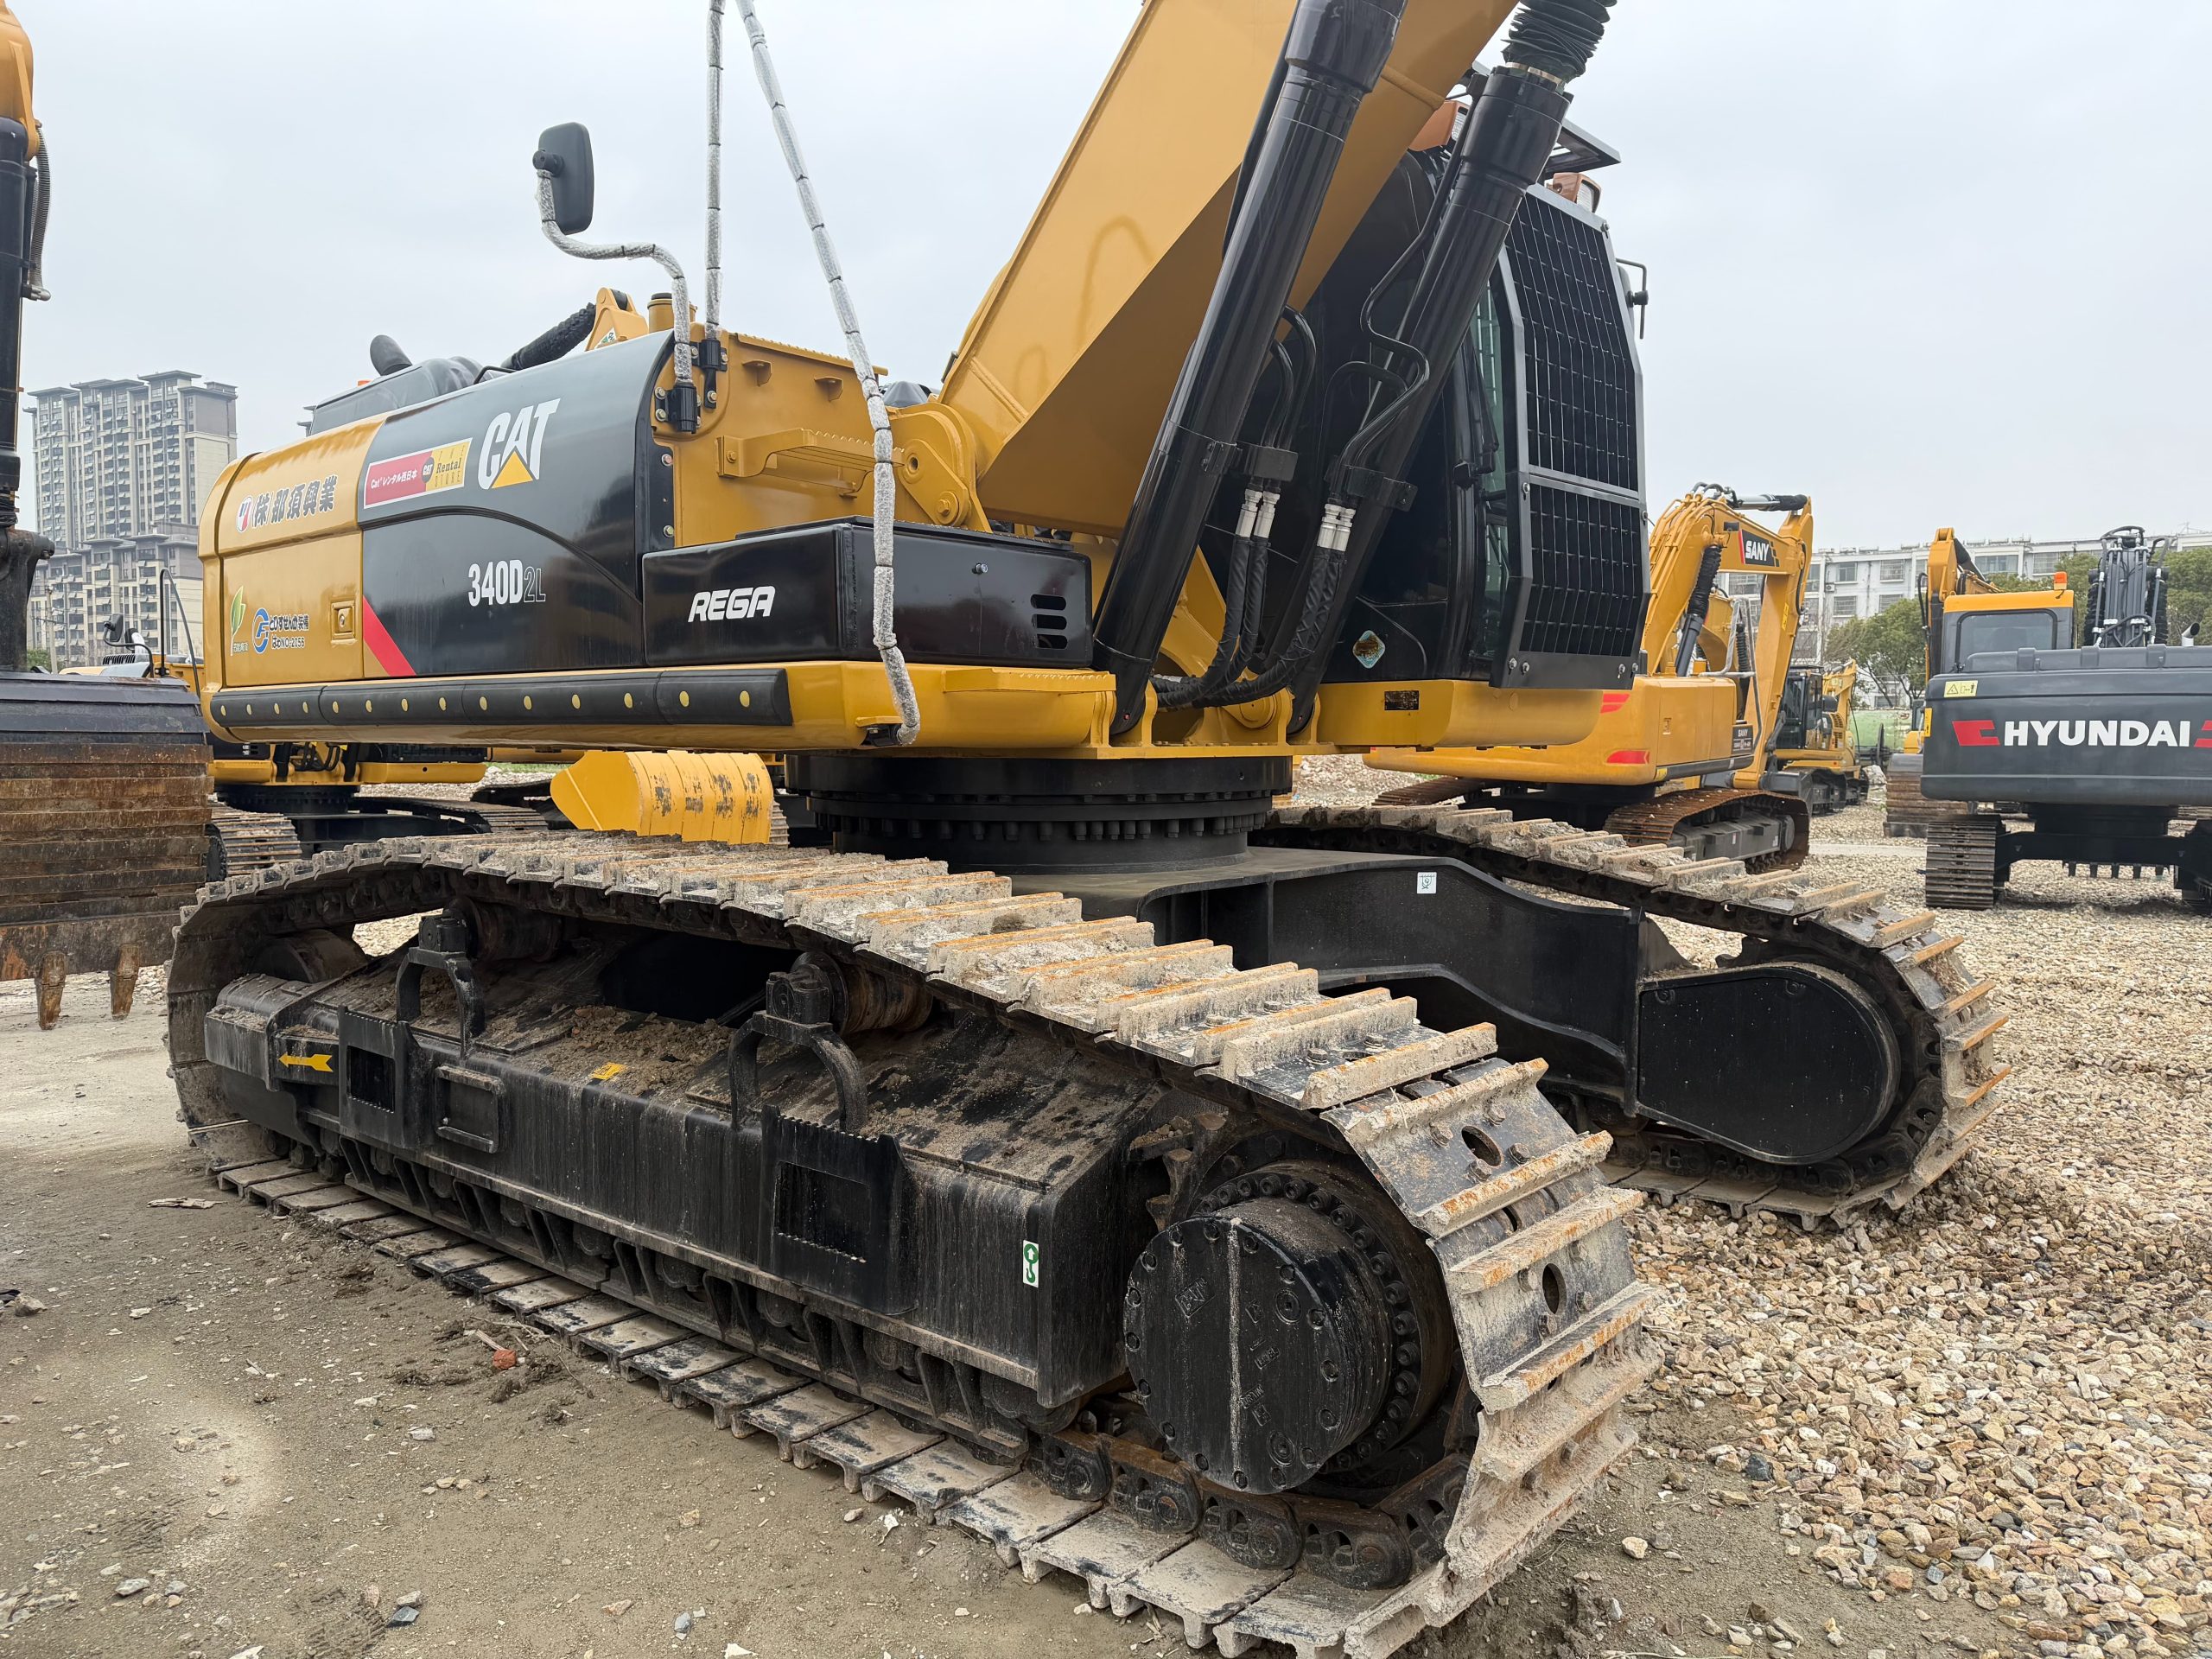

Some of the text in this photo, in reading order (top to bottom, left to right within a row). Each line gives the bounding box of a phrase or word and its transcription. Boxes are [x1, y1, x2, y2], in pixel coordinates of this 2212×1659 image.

[478, 398, 561, 490] CAT
[423, 464, 433, 476] CAT
[436, 457, 462, 474] Rental
[1745, 540, 1770, 562] SANY
[688, 586, 776, 623] REGA
[2004, 720, 2191, 747] HYUNDAI
